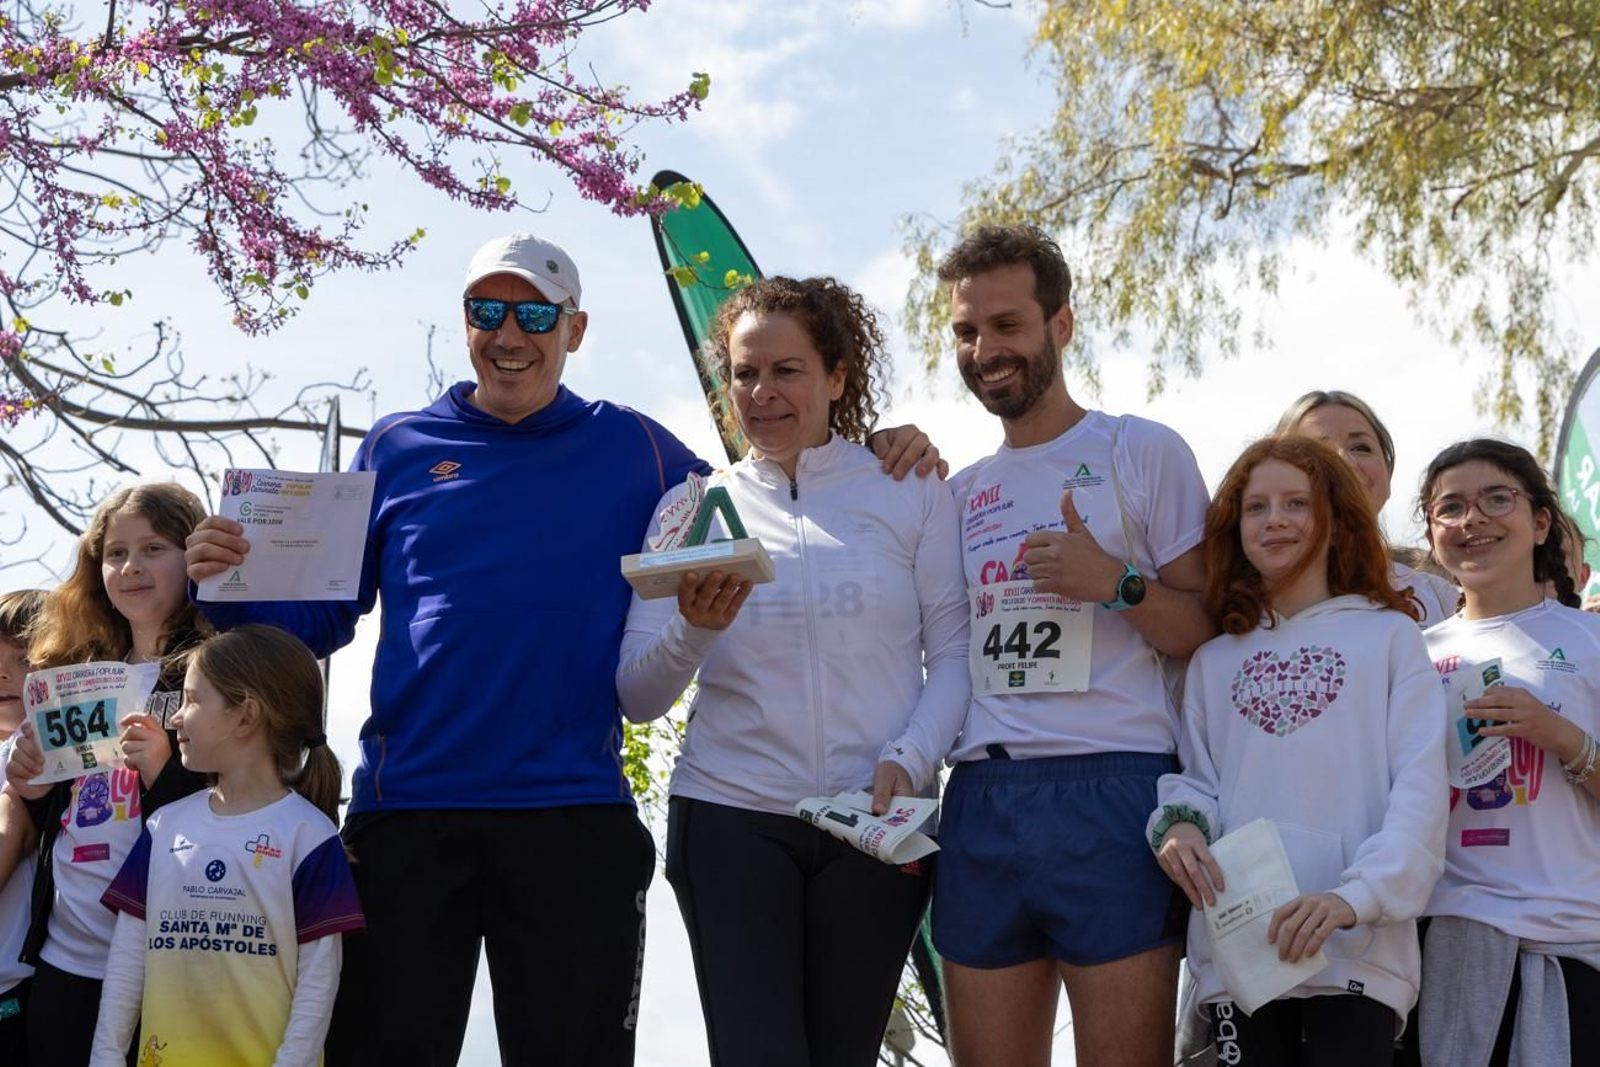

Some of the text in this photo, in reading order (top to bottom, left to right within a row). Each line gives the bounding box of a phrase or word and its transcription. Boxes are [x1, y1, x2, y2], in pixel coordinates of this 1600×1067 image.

[983, 621, 1062, 661] 442
[1017, 661, 1038, 669] FELIPE
[45, 701, 109, 748] 564
[183, 885, 246, 897] PABLO CARVAJAL
[160, 909, 267, 926] CLUB DE RUNNING
[159, 920, 210, 934] SANTA
[242, 925, 265, 939] DE
[179, 934, 277, 957] APÓSTOLES
